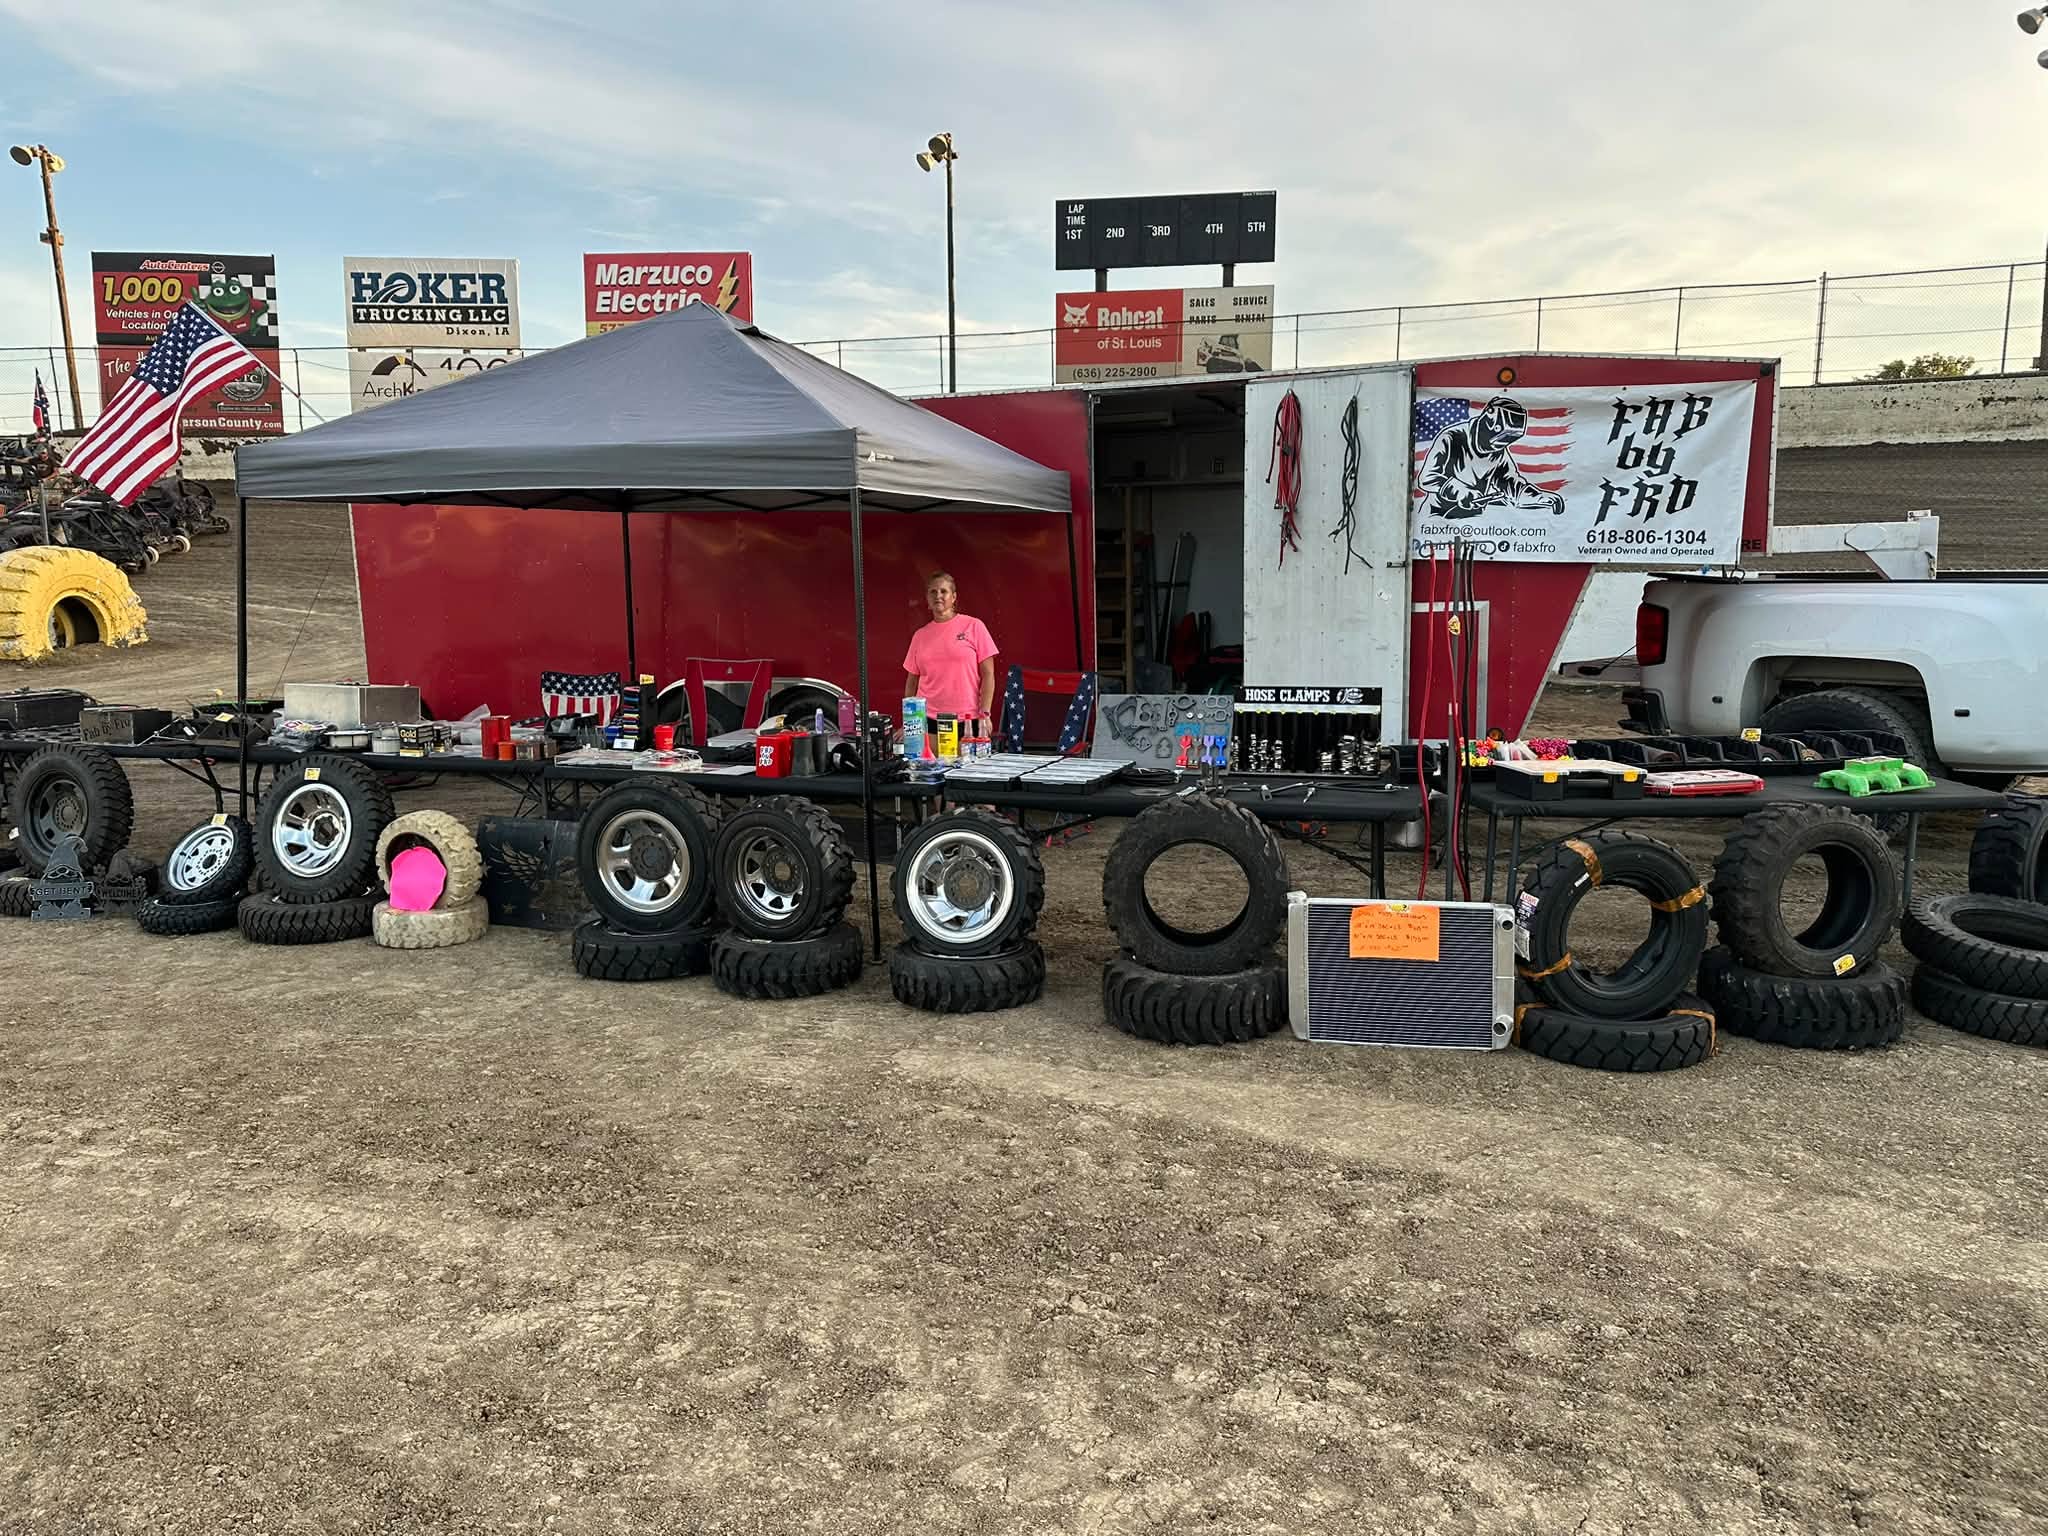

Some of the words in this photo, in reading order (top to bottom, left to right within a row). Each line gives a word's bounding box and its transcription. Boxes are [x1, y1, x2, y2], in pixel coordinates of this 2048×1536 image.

[1068, 204, 1084, 213] LAP
[1066, 216, 1086, 225] TIME
[1065, 229, 1083, 240] 1ST
[1106, 228, 1125, 238] 2ND
[1152, 226, 1171, 236] 3RD
[1205, 223, 1223, 234] 4TH
[1247, 222, 1266, 232] 5TH
[139, 259, 210, 272] AutoCenters
[595, 263, 713, 287] Marzuco
[102, 276, 183, 306] 1,000
[350, 271, 509, 304] HOKER
[1189, 298, 1216, 308] SALES
[1232, 296, 1268, 306] SERVICE
[105, 309, 149, 319] Vehicles
[151, 309, 161, 319] in
[356, 308, 463, 322] TRUCKING
[468, 309, 507, 322] LLC
[1097, 306, 1164, 331] Bobcat
[446, 326, 491, 337] Dixon,
[495, 327, 510, 336] IA
[1097, 338, 1110, 350] of
[1112, 338, 1127, 349] St.
[1129, 336, 1162, 349] Louis
[103, 358, 131, 378] The
[1072, 366, 1101, 381] (636)
[1105, 366, 1157, 378] 225-2900
[182, 416, 282, 431] ersonCounty.com
[1607, 391, 1713, 445] FAB
[1616, 431, 1677, 478] by
[1420, 524, 1546, 538] fabxfro@outlook.com
[1586, 529, 1707, 545] 618-806-1304
[1513, 541, 1556, 553] fabxfro
[1577, 546, 1612, 555] Veteran
[1615, 546, 1647, 555] Owned
[1650, 547, 1668, 555] and
[1670, 547, 1714, 557] Operated
[1245, 688, 1276, 702] HOSE
[1280, 689, 1331, 703] CLAMPS
[400, 729, 417, 739] Gold
